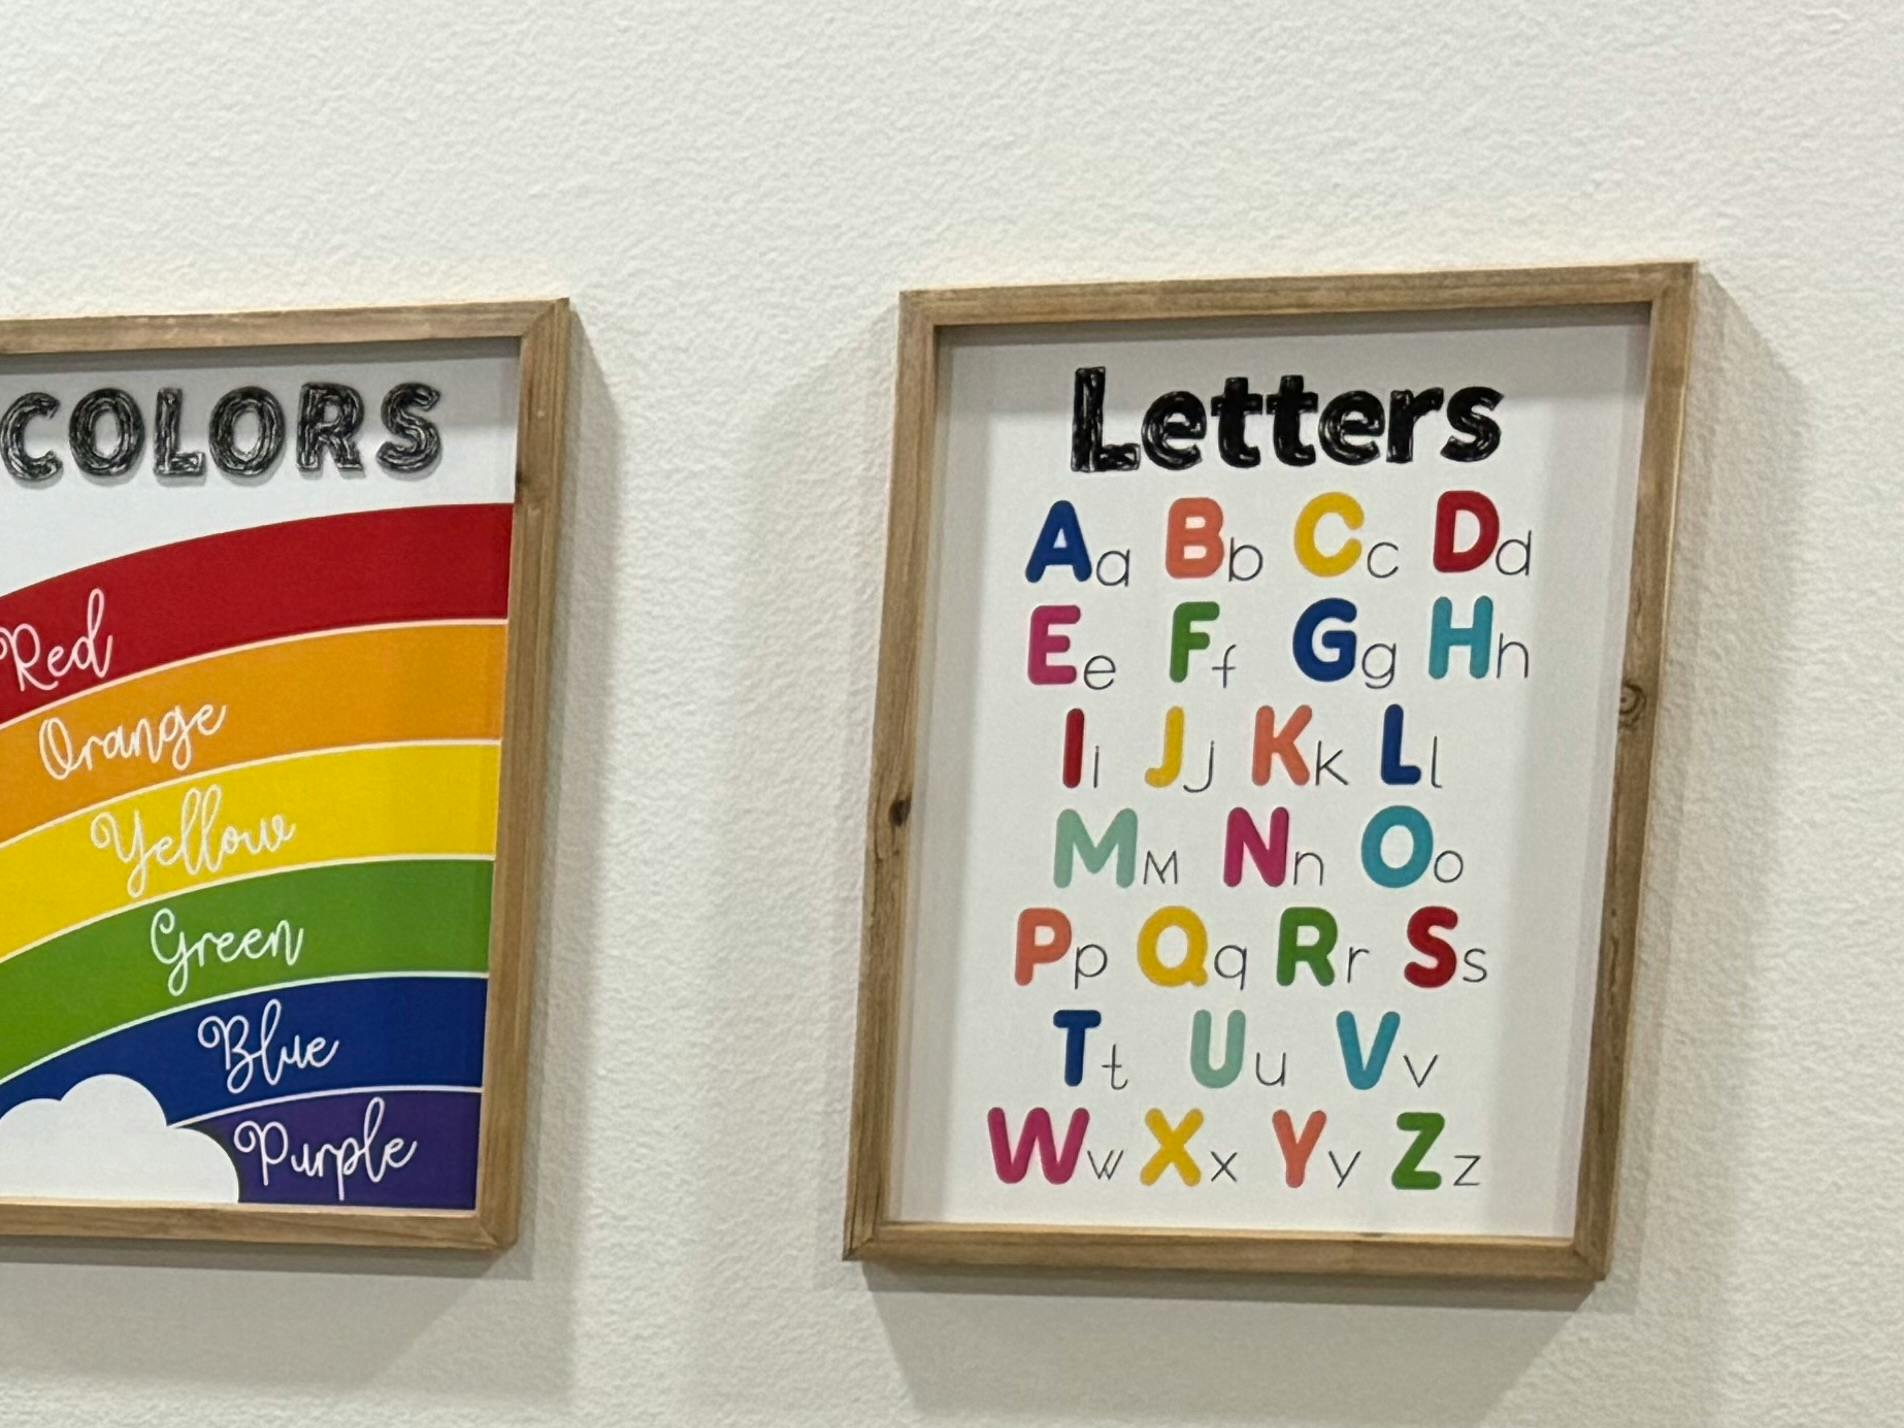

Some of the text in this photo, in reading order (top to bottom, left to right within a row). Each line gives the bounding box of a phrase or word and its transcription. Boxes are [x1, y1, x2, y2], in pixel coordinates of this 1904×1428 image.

[1072, 366, 1504, 473] Letters
[39, 703, 226, 780] Orange
[90, 784, 297, 898] Yellow
[150, 908, 304, 996] Green
[198, 998, 340, 1094] Blue
[233, 1097, 418, 1201] Purple
